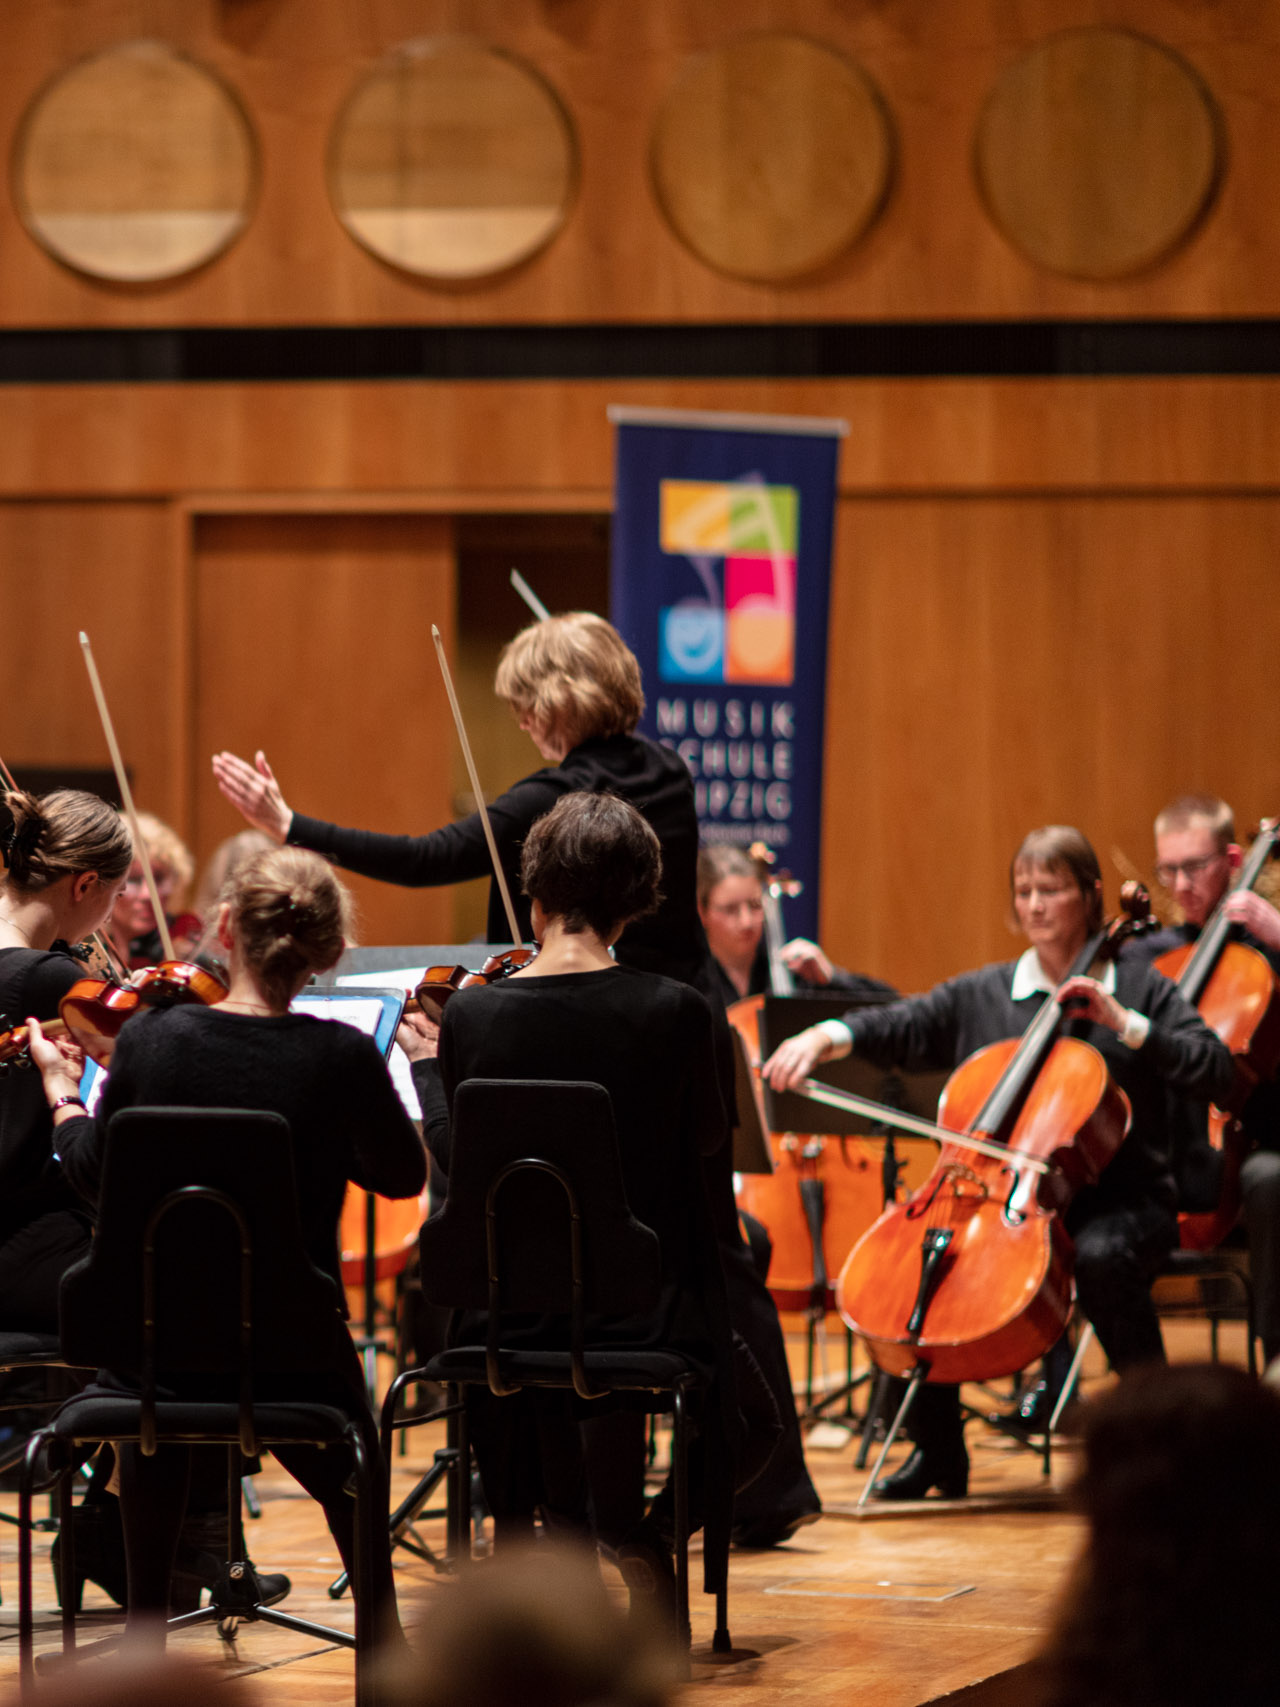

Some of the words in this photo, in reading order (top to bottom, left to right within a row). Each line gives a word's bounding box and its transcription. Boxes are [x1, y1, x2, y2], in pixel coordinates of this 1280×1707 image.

[657, 699, 795, 739] MUSIK
[660, 738, 793, 779] CHULE
[694, 780, 792, 820] IPZIG
